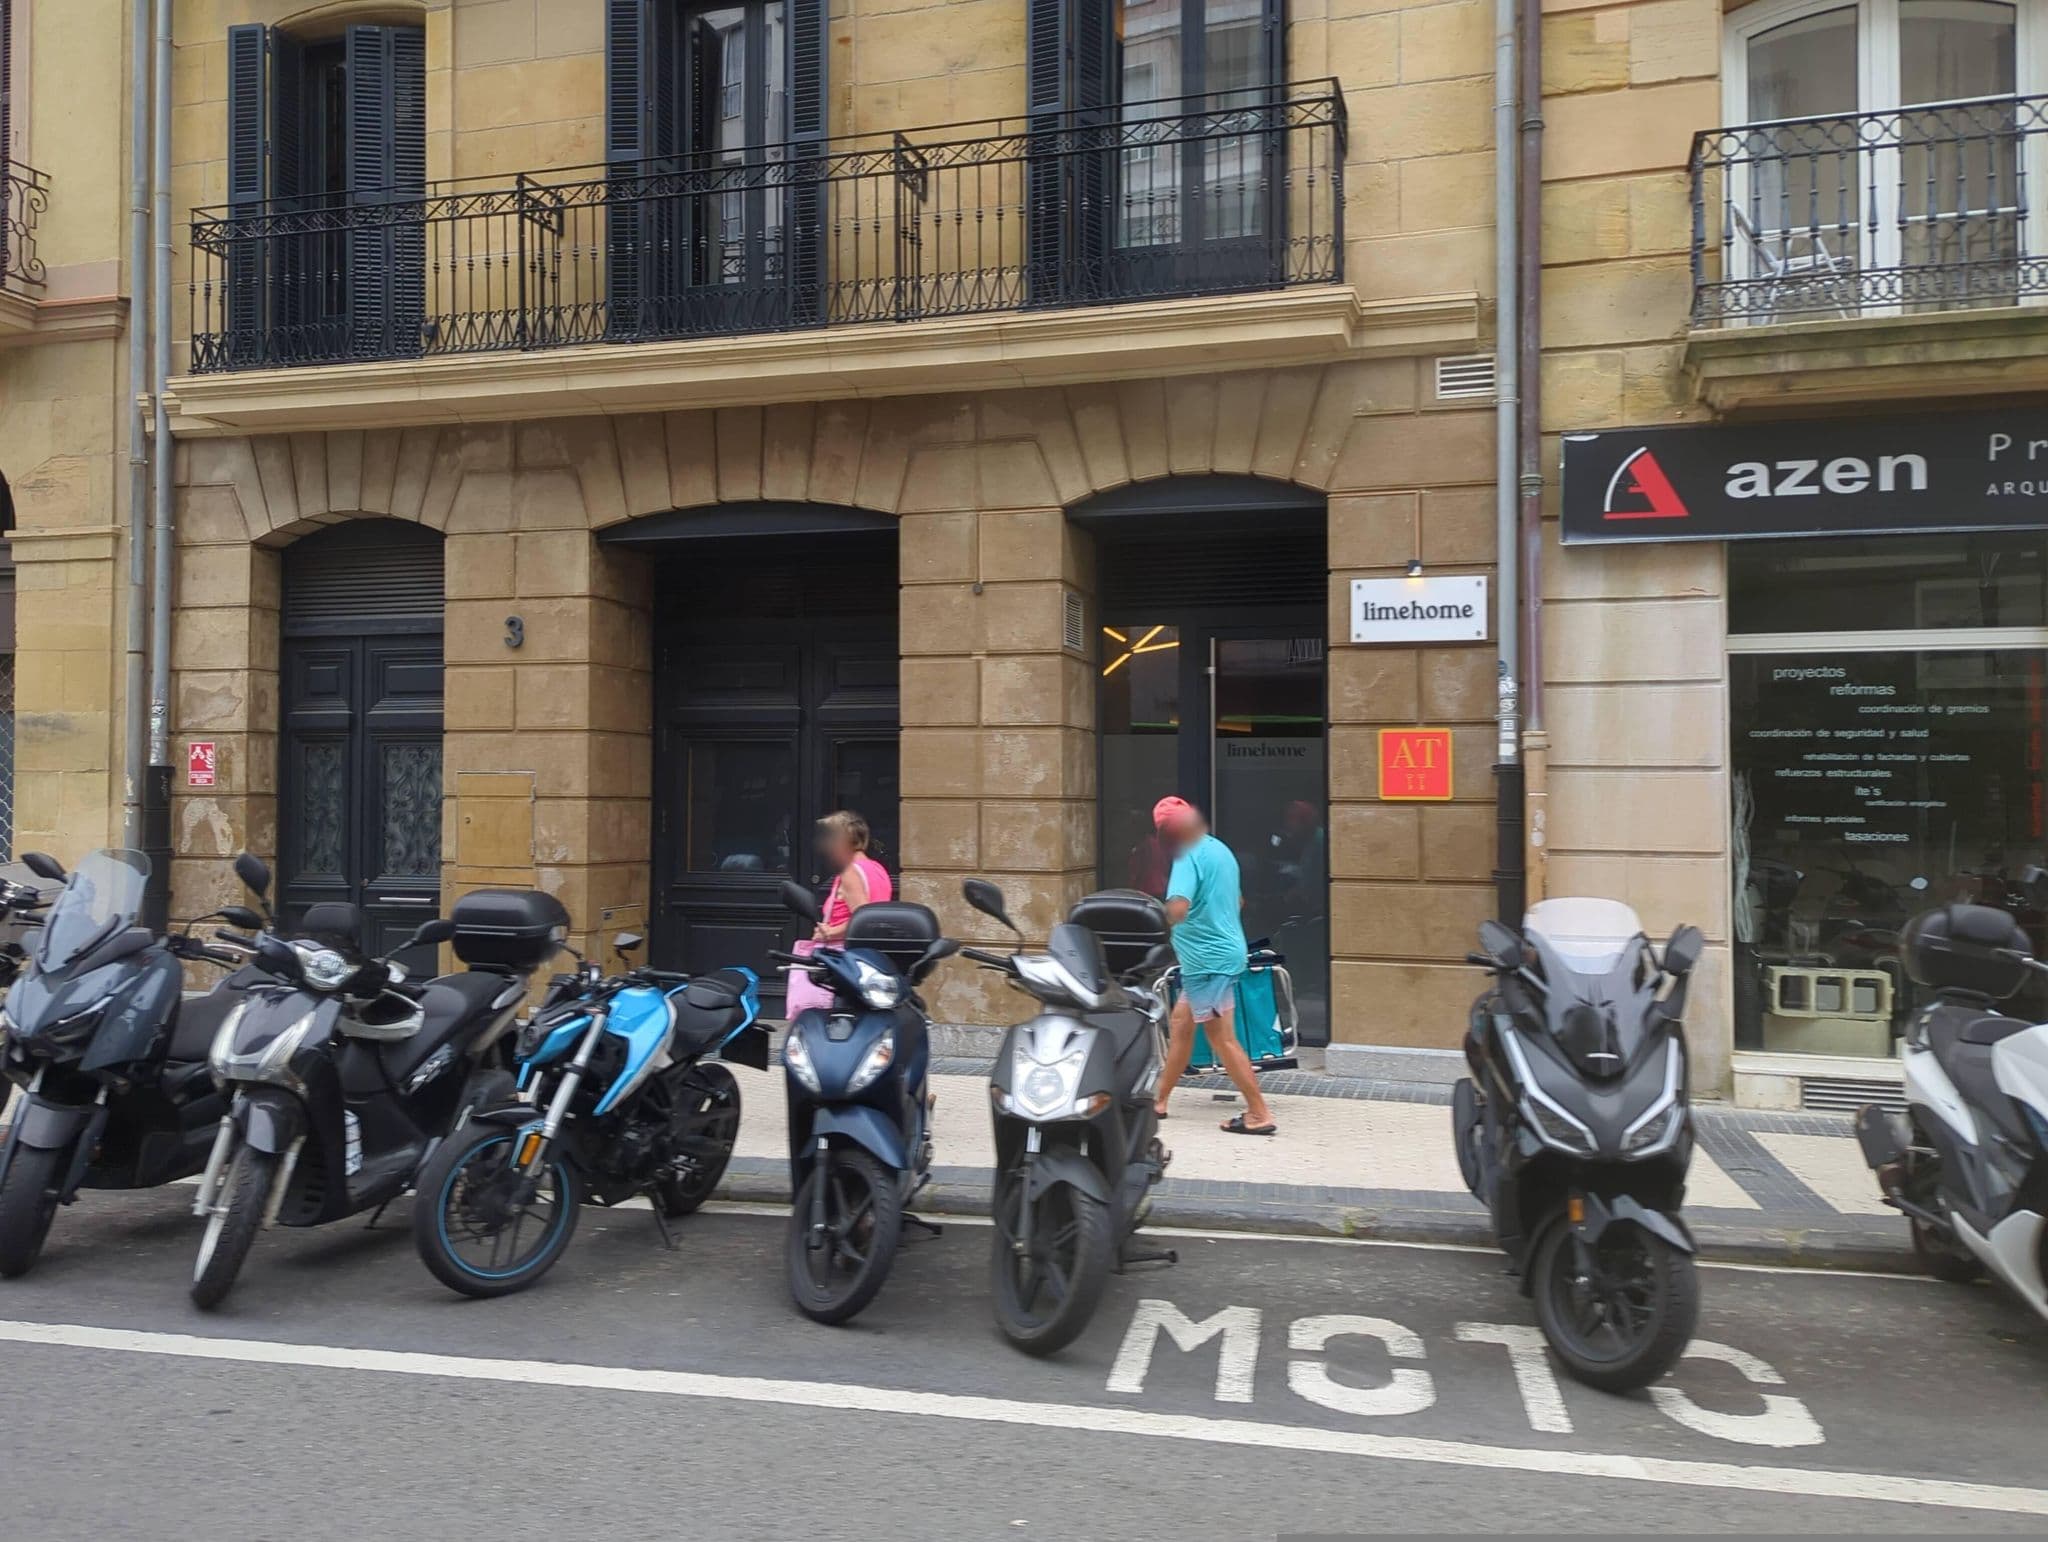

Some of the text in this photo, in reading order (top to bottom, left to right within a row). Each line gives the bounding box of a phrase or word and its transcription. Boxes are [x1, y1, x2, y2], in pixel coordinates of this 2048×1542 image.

[1724, 453, 1928, 499] azen
[1363, 601, 1474, 621] limehome
[504, 616, 524, 648] 3
[1773, 666, 1847, 681] proyectos
[1829, 683, 1896, 696] reformas
[1928, 704, 1943, 714] de
[1816, 729, 1831, 738] de
[1833, 729, 1885, 740] seguridad
[1889, 730, 1896, 740] y
[1900, 729, 1930, 739] salud
[1226, 743, 1306, 758] limehome
[1388, 738, 1442, 769] AT
[1862, 753, 1875, 761] de
[1845, 832, 1909, 842] tasaciones
[1106, 1299, 1826, 1448] MOTO
